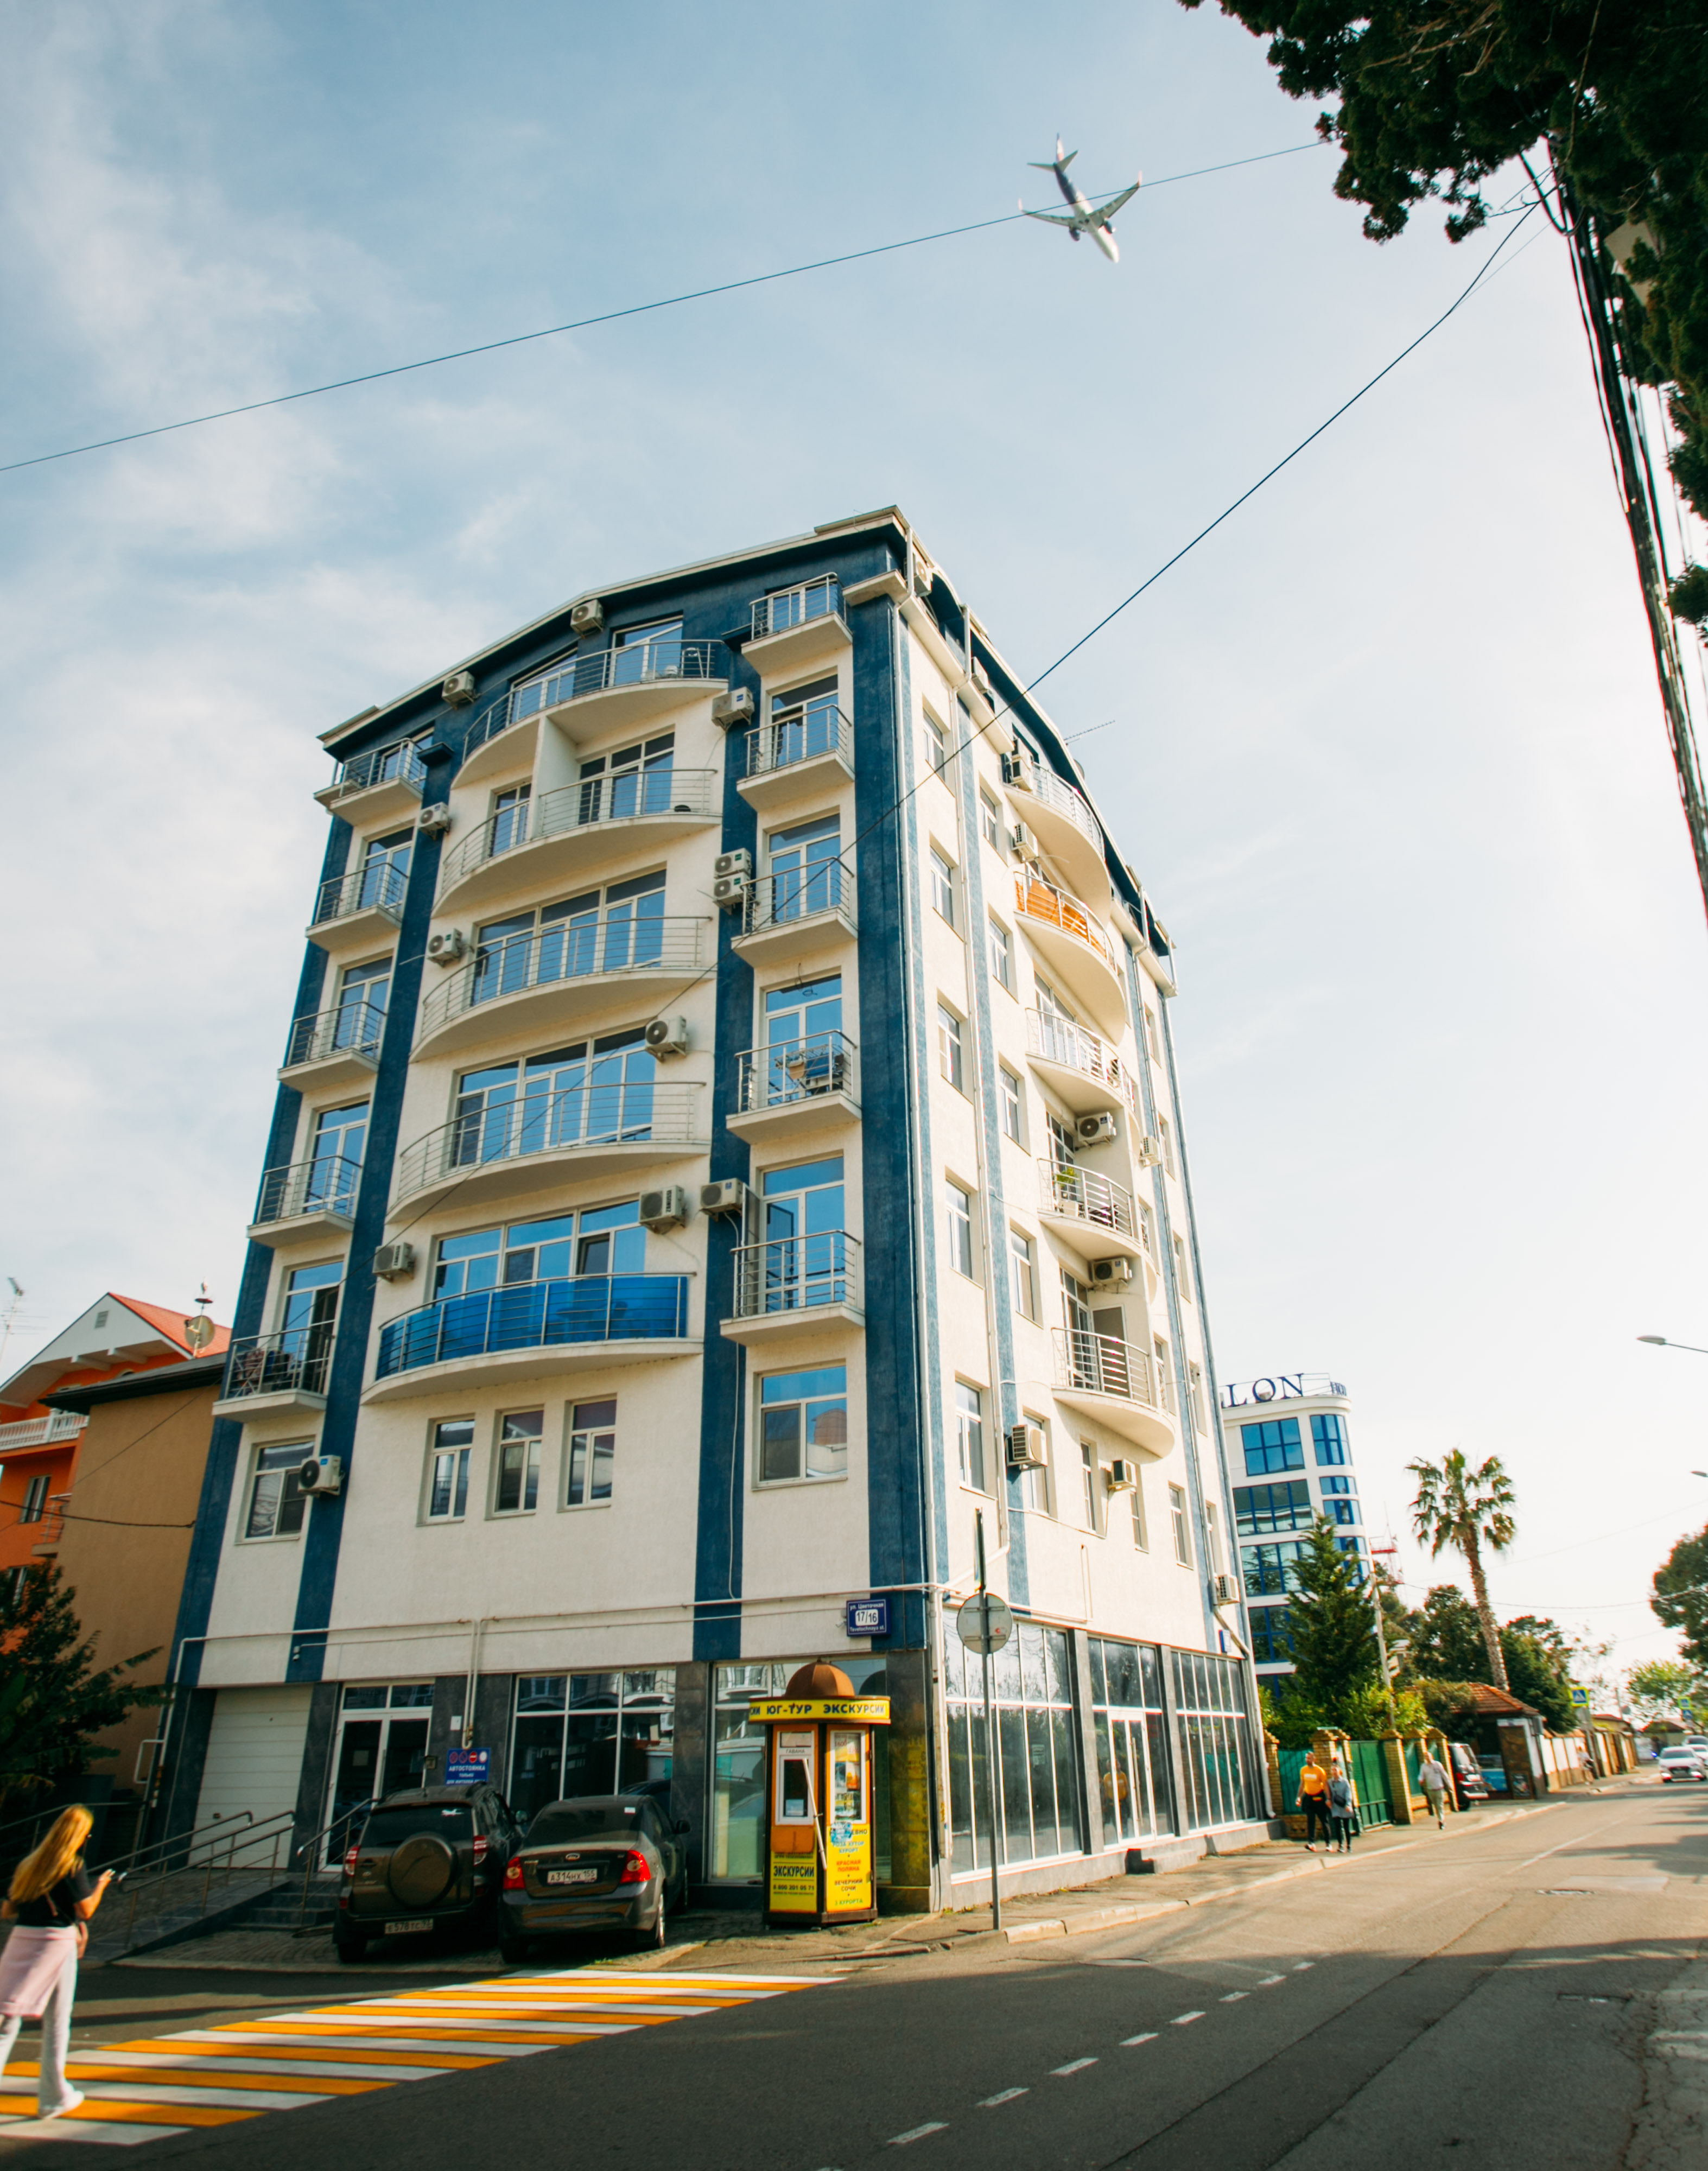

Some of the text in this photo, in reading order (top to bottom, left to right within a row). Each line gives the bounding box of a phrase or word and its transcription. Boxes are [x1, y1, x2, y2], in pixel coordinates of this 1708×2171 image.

[1221, 1373, 1305, 1408] LON
[856, 1611, 877, 1623] 17/16
[766, 1704, 812, 1715] ЮГ-ТУР
[823, 1704, 885, 1714] ЭКСКУРСИИ
[773, 1865, 814, 1877] ЭКСКУРСИИ
